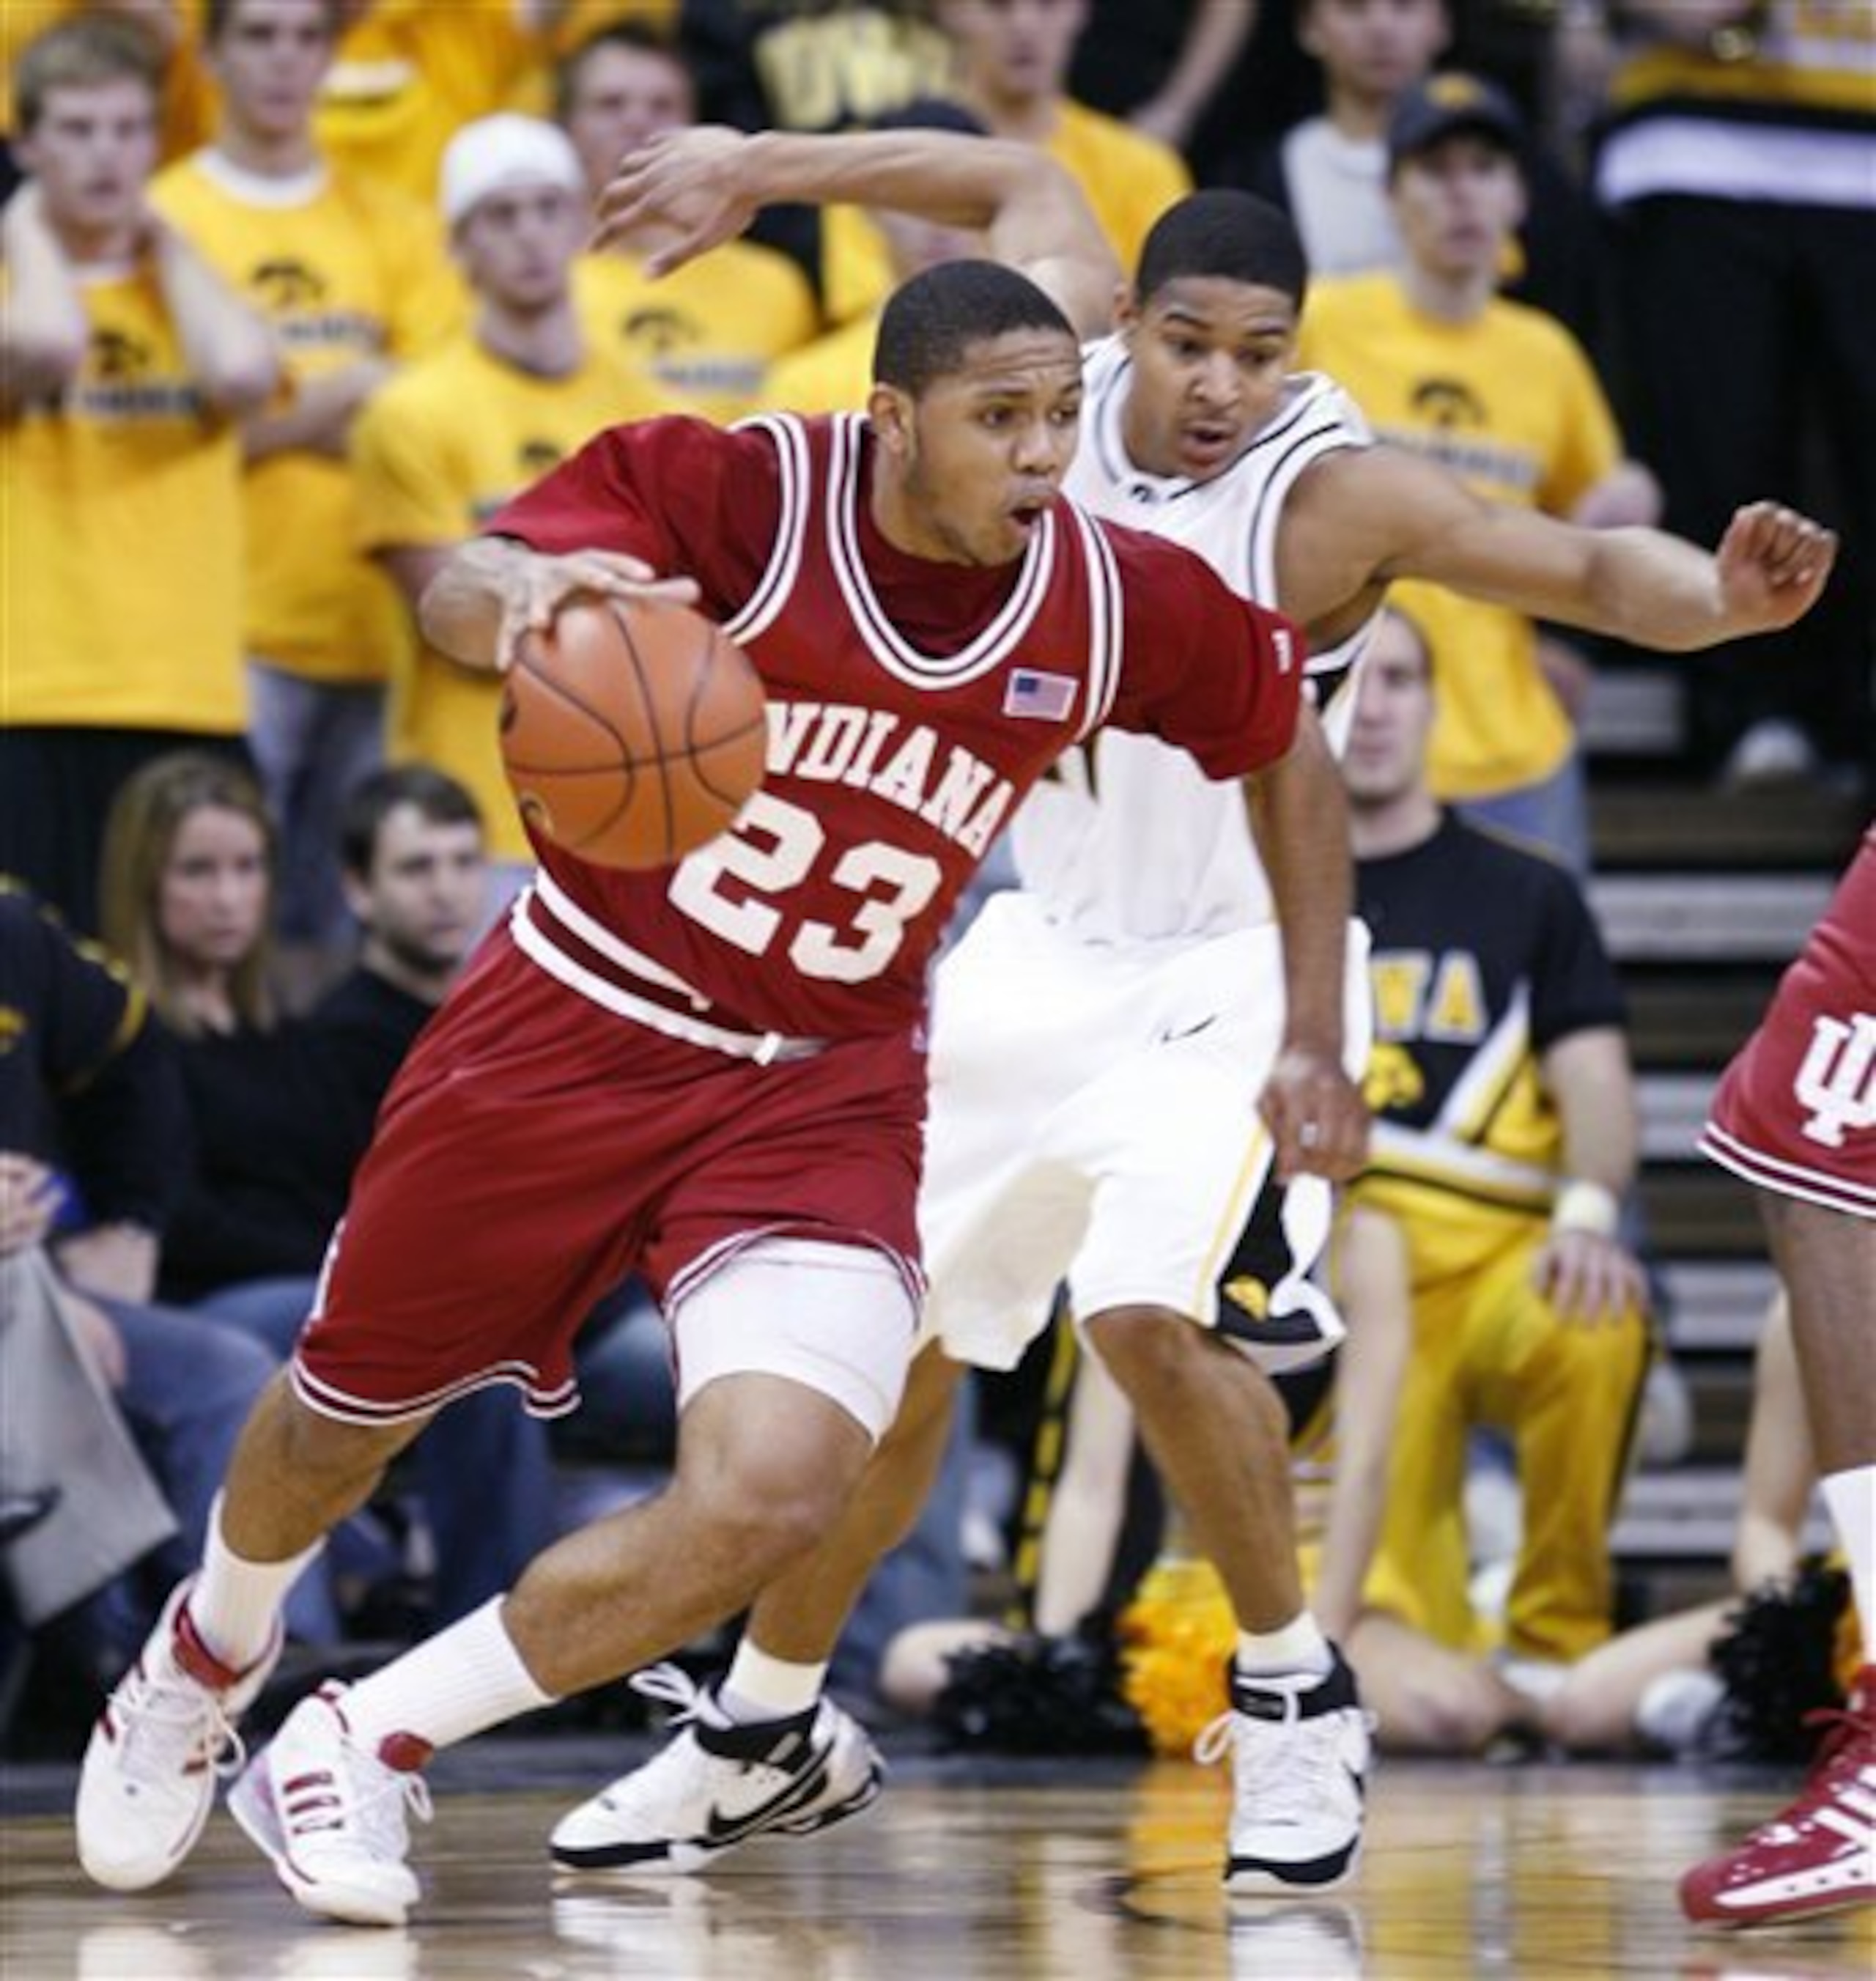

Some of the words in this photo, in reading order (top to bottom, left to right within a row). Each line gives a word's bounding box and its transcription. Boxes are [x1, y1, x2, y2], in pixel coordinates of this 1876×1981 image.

[764, 701, 1016, 860] NDIANA
[667, 789, 942, 984] 23
[1369, 948, 1491, 1043] WA
